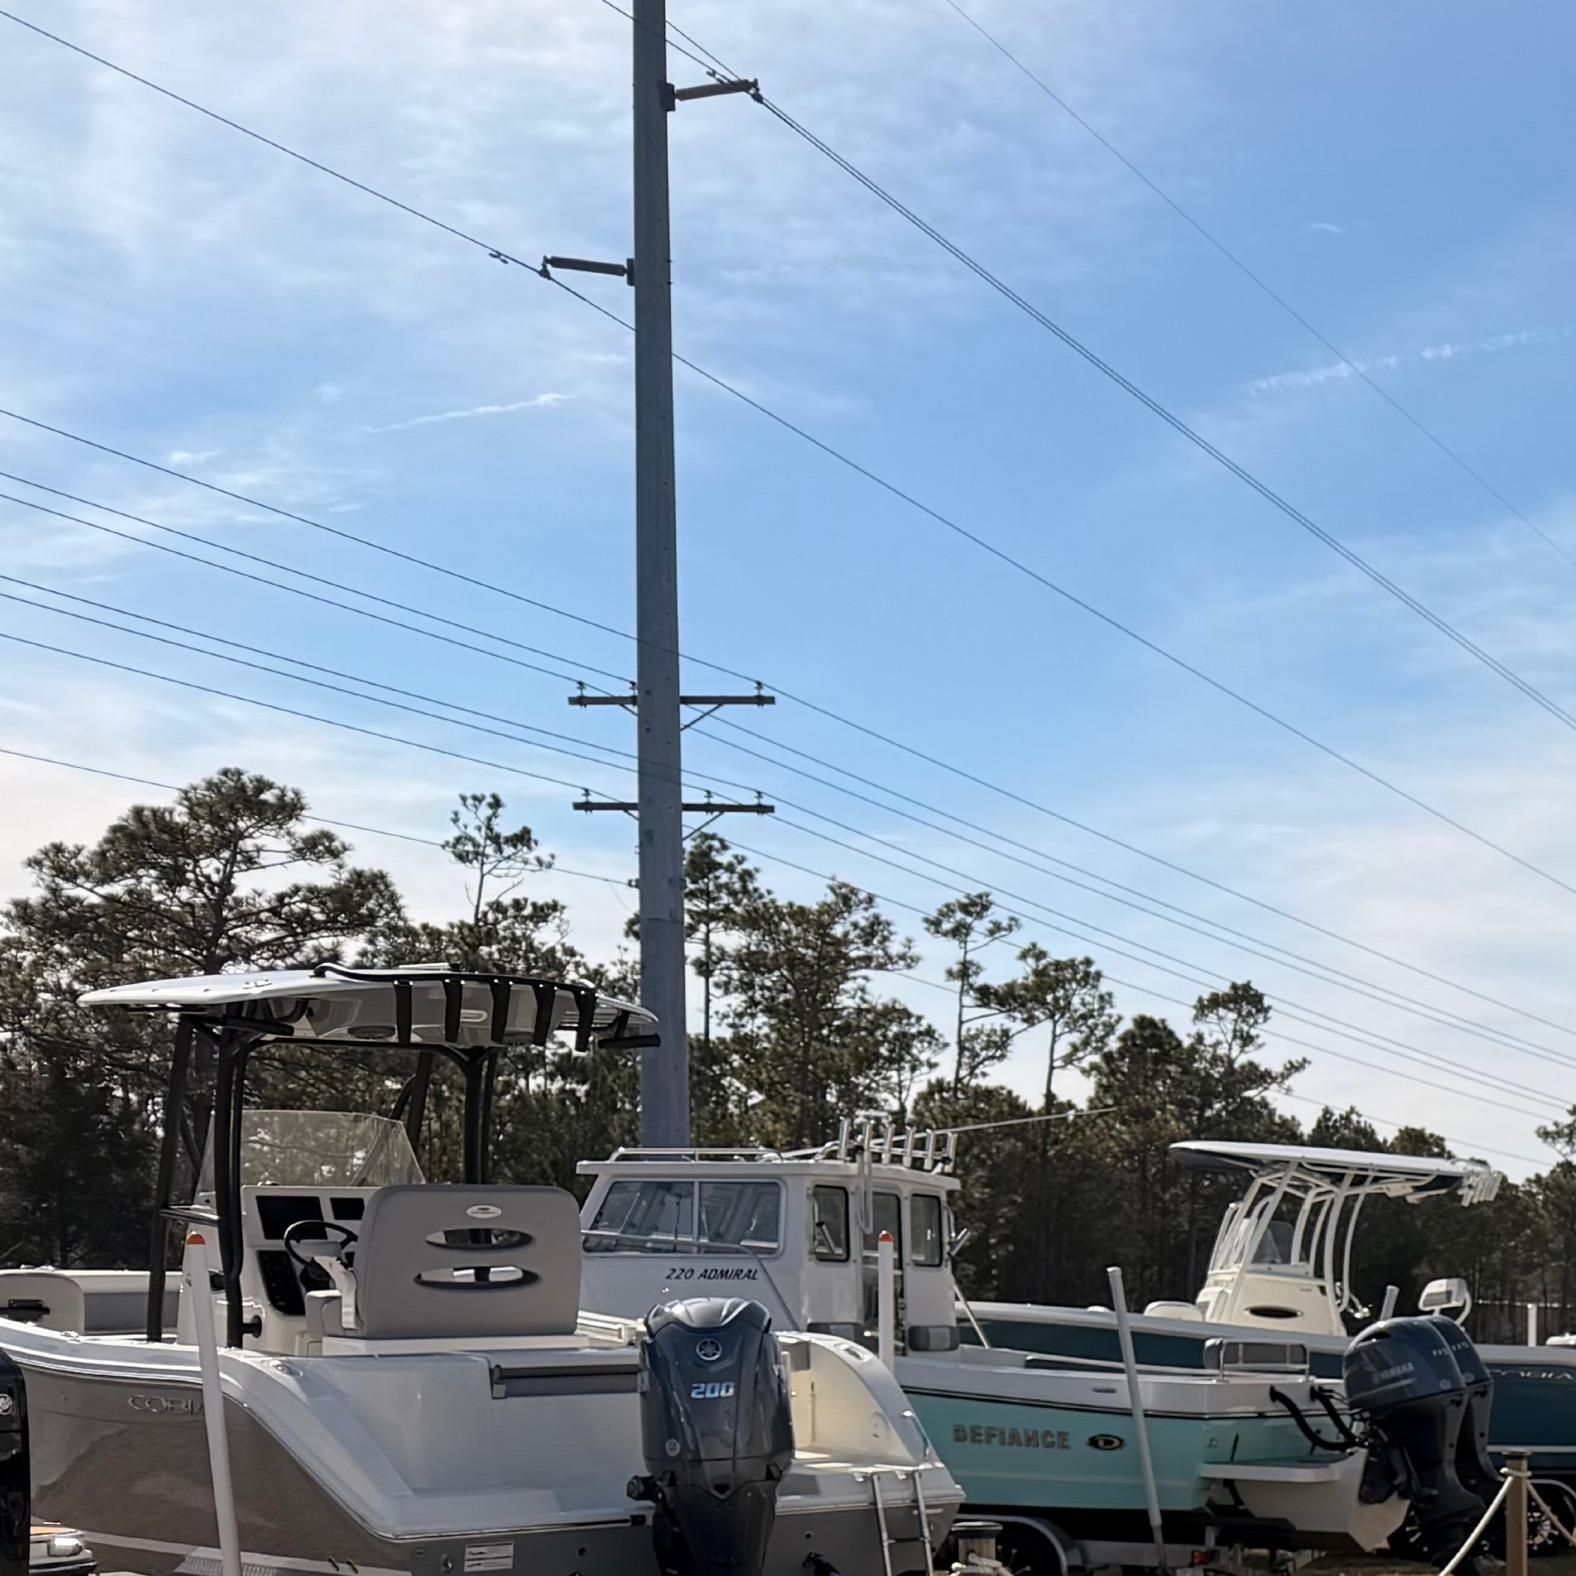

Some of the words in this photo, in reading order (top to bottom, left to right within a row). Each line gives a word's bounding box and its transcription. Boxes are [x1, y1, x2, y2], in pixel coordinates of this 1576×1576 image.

[665, 1268, 695, 1280] 220
[697, 1268, 758, 1281] ADMIRAL
[690, 1382, 735, 1399] 200
[128, 1394, 204, 1415] COBI
[953, 1424, 1071, 1449] DEFIANCE
